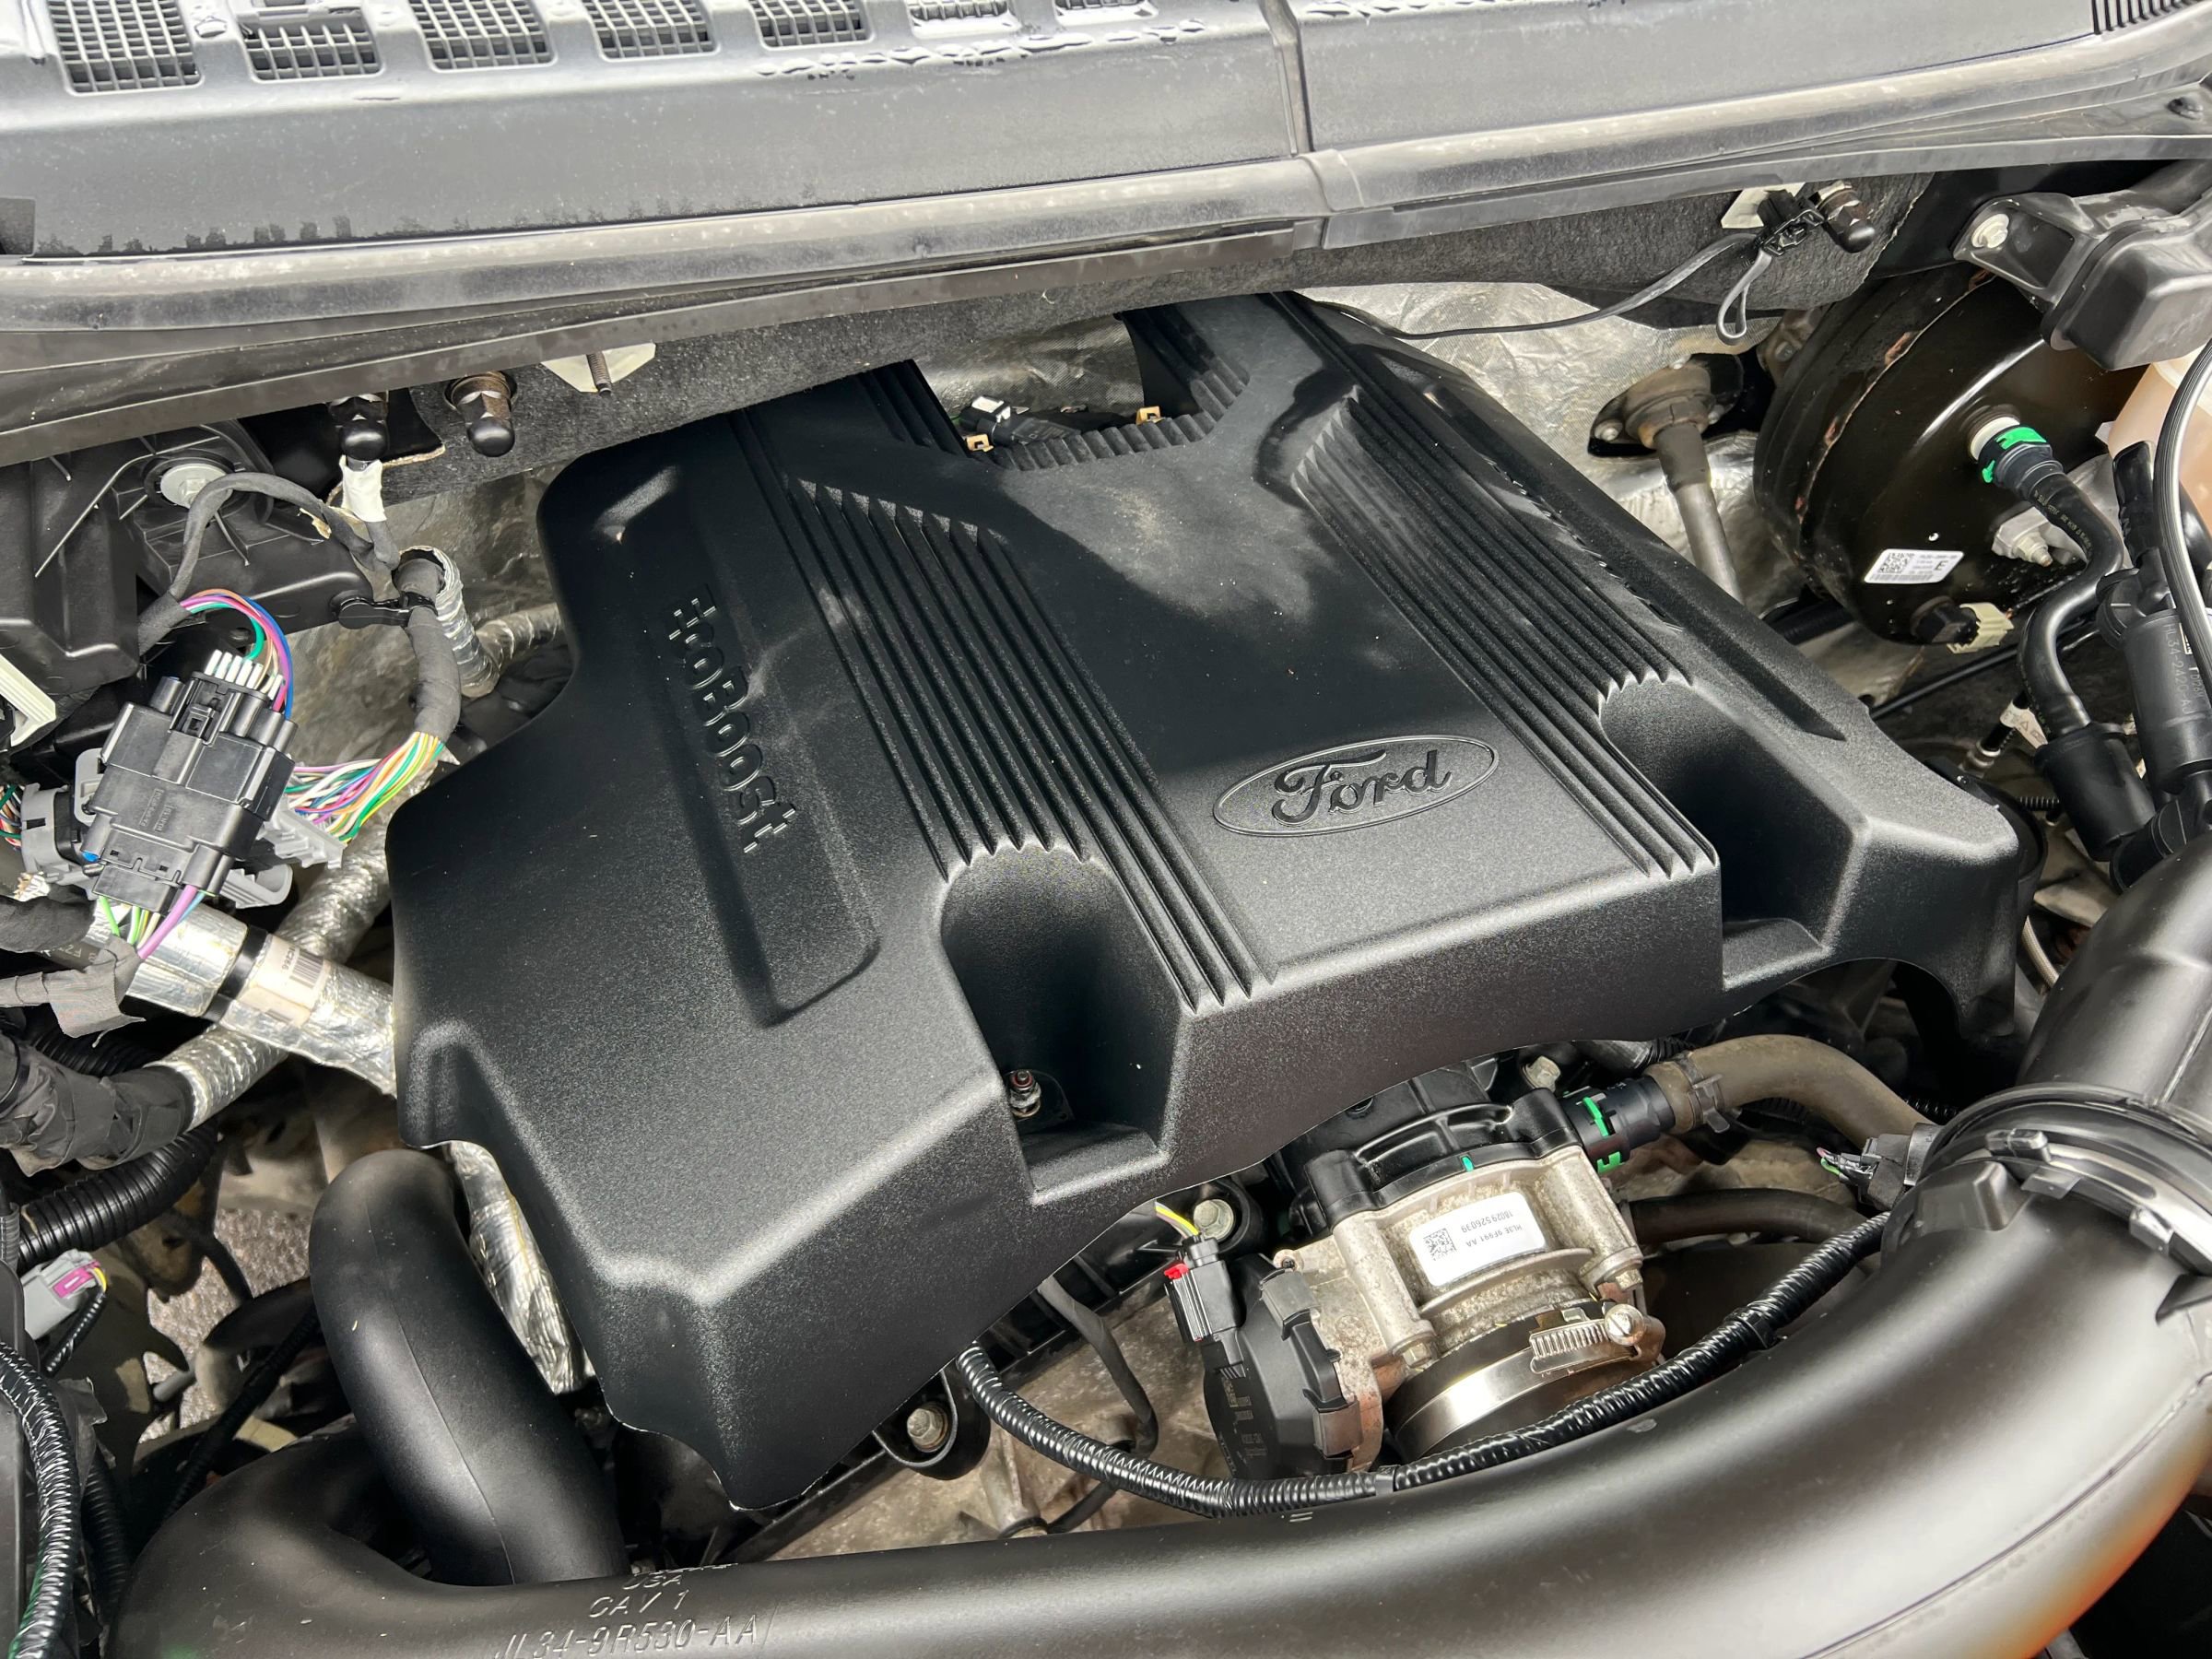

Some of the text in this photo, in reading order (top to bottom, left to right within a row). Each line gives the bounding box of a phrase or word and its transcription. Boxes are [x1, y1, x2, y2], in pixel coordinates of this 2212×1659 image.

[665, 582, 796, 853] EcoBoost
[1271, 748, 1453, 827] Ford
[1466, 1239, 1477, 1247] AA
